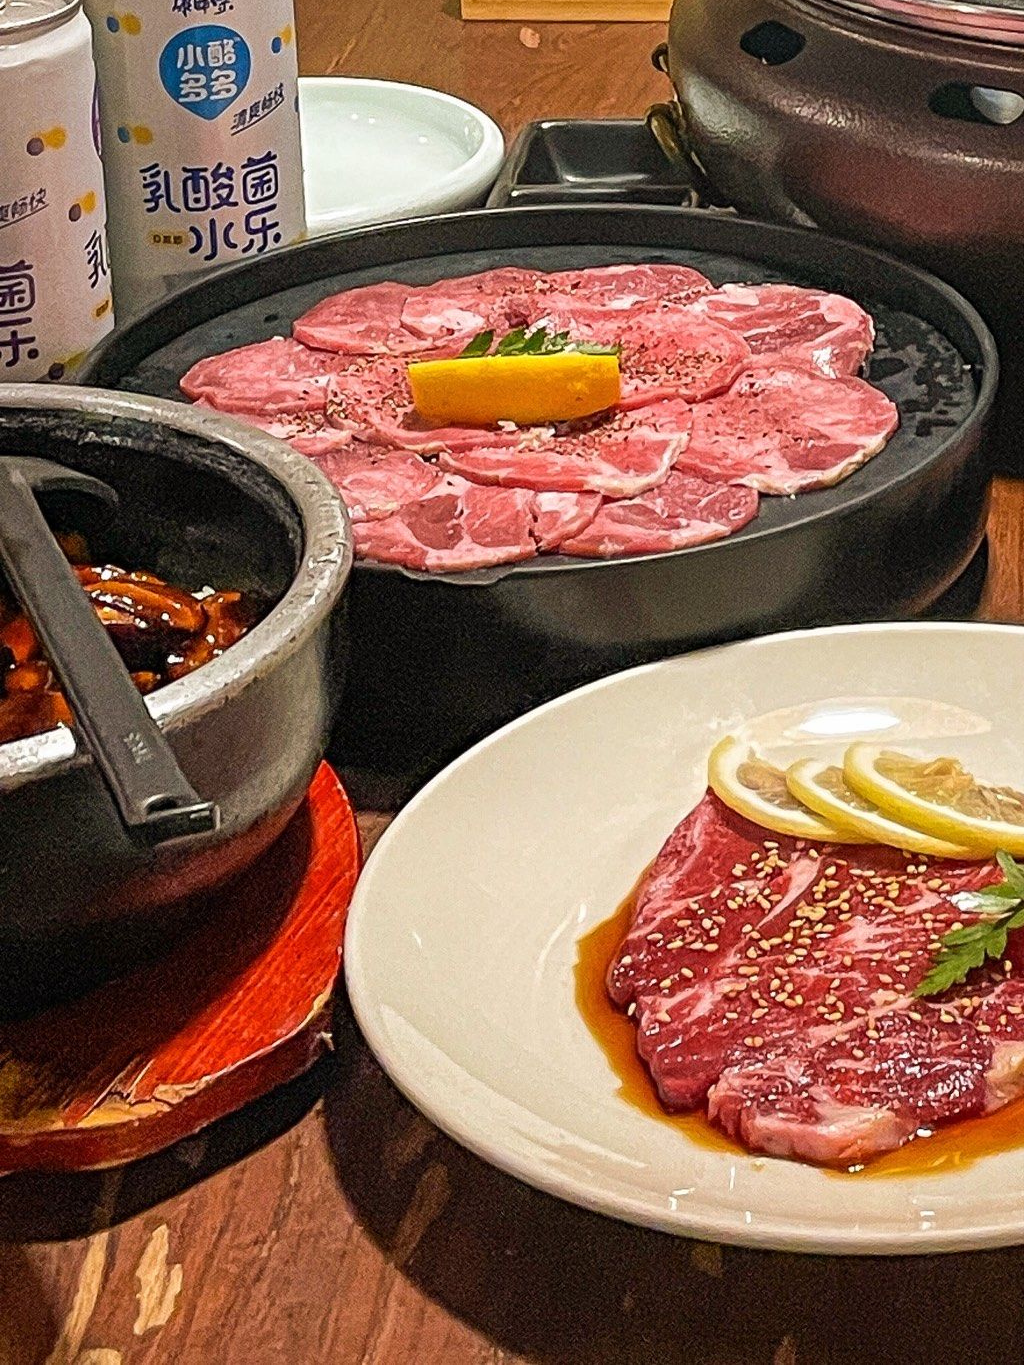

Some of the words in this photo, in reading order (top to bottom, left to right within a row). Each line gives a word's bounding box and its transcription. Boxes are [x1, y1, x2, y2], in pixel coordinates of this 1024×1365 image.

[177, 38, 237, 71] 小酪
[178, 69, 238, 103] 多多
[139, 150, 279, 214] 乳酸菌
[188, 203, 282, 262] 水乐
